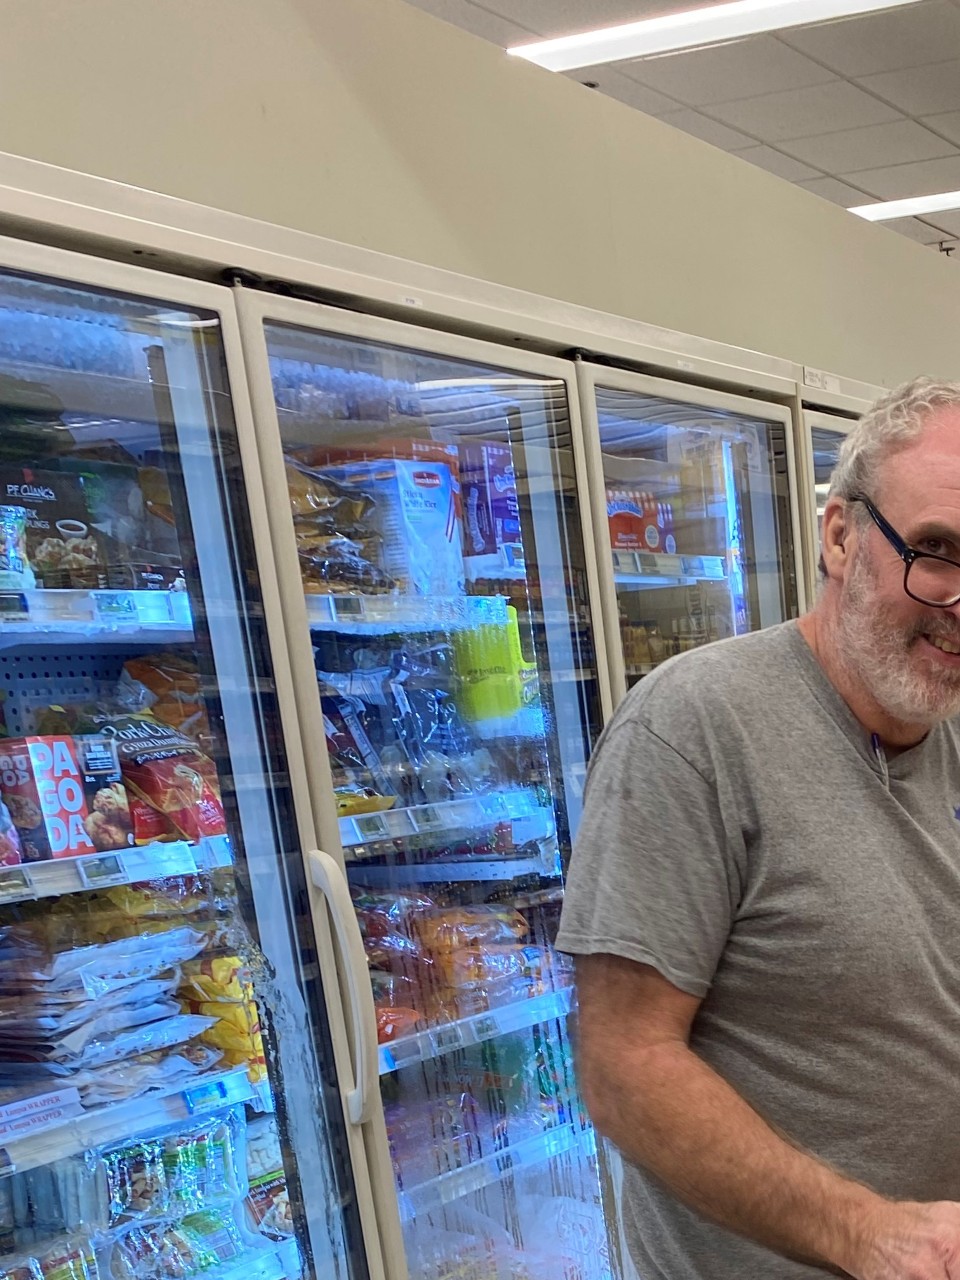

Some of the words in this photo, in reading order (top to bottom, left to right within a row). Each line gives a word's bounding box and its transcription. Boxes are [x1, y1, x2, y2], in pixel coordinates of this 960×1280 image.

[32, 742, 78, 778] PA
[38, 778, 83, 815] GO
[46, 815, 94, 853] DA
